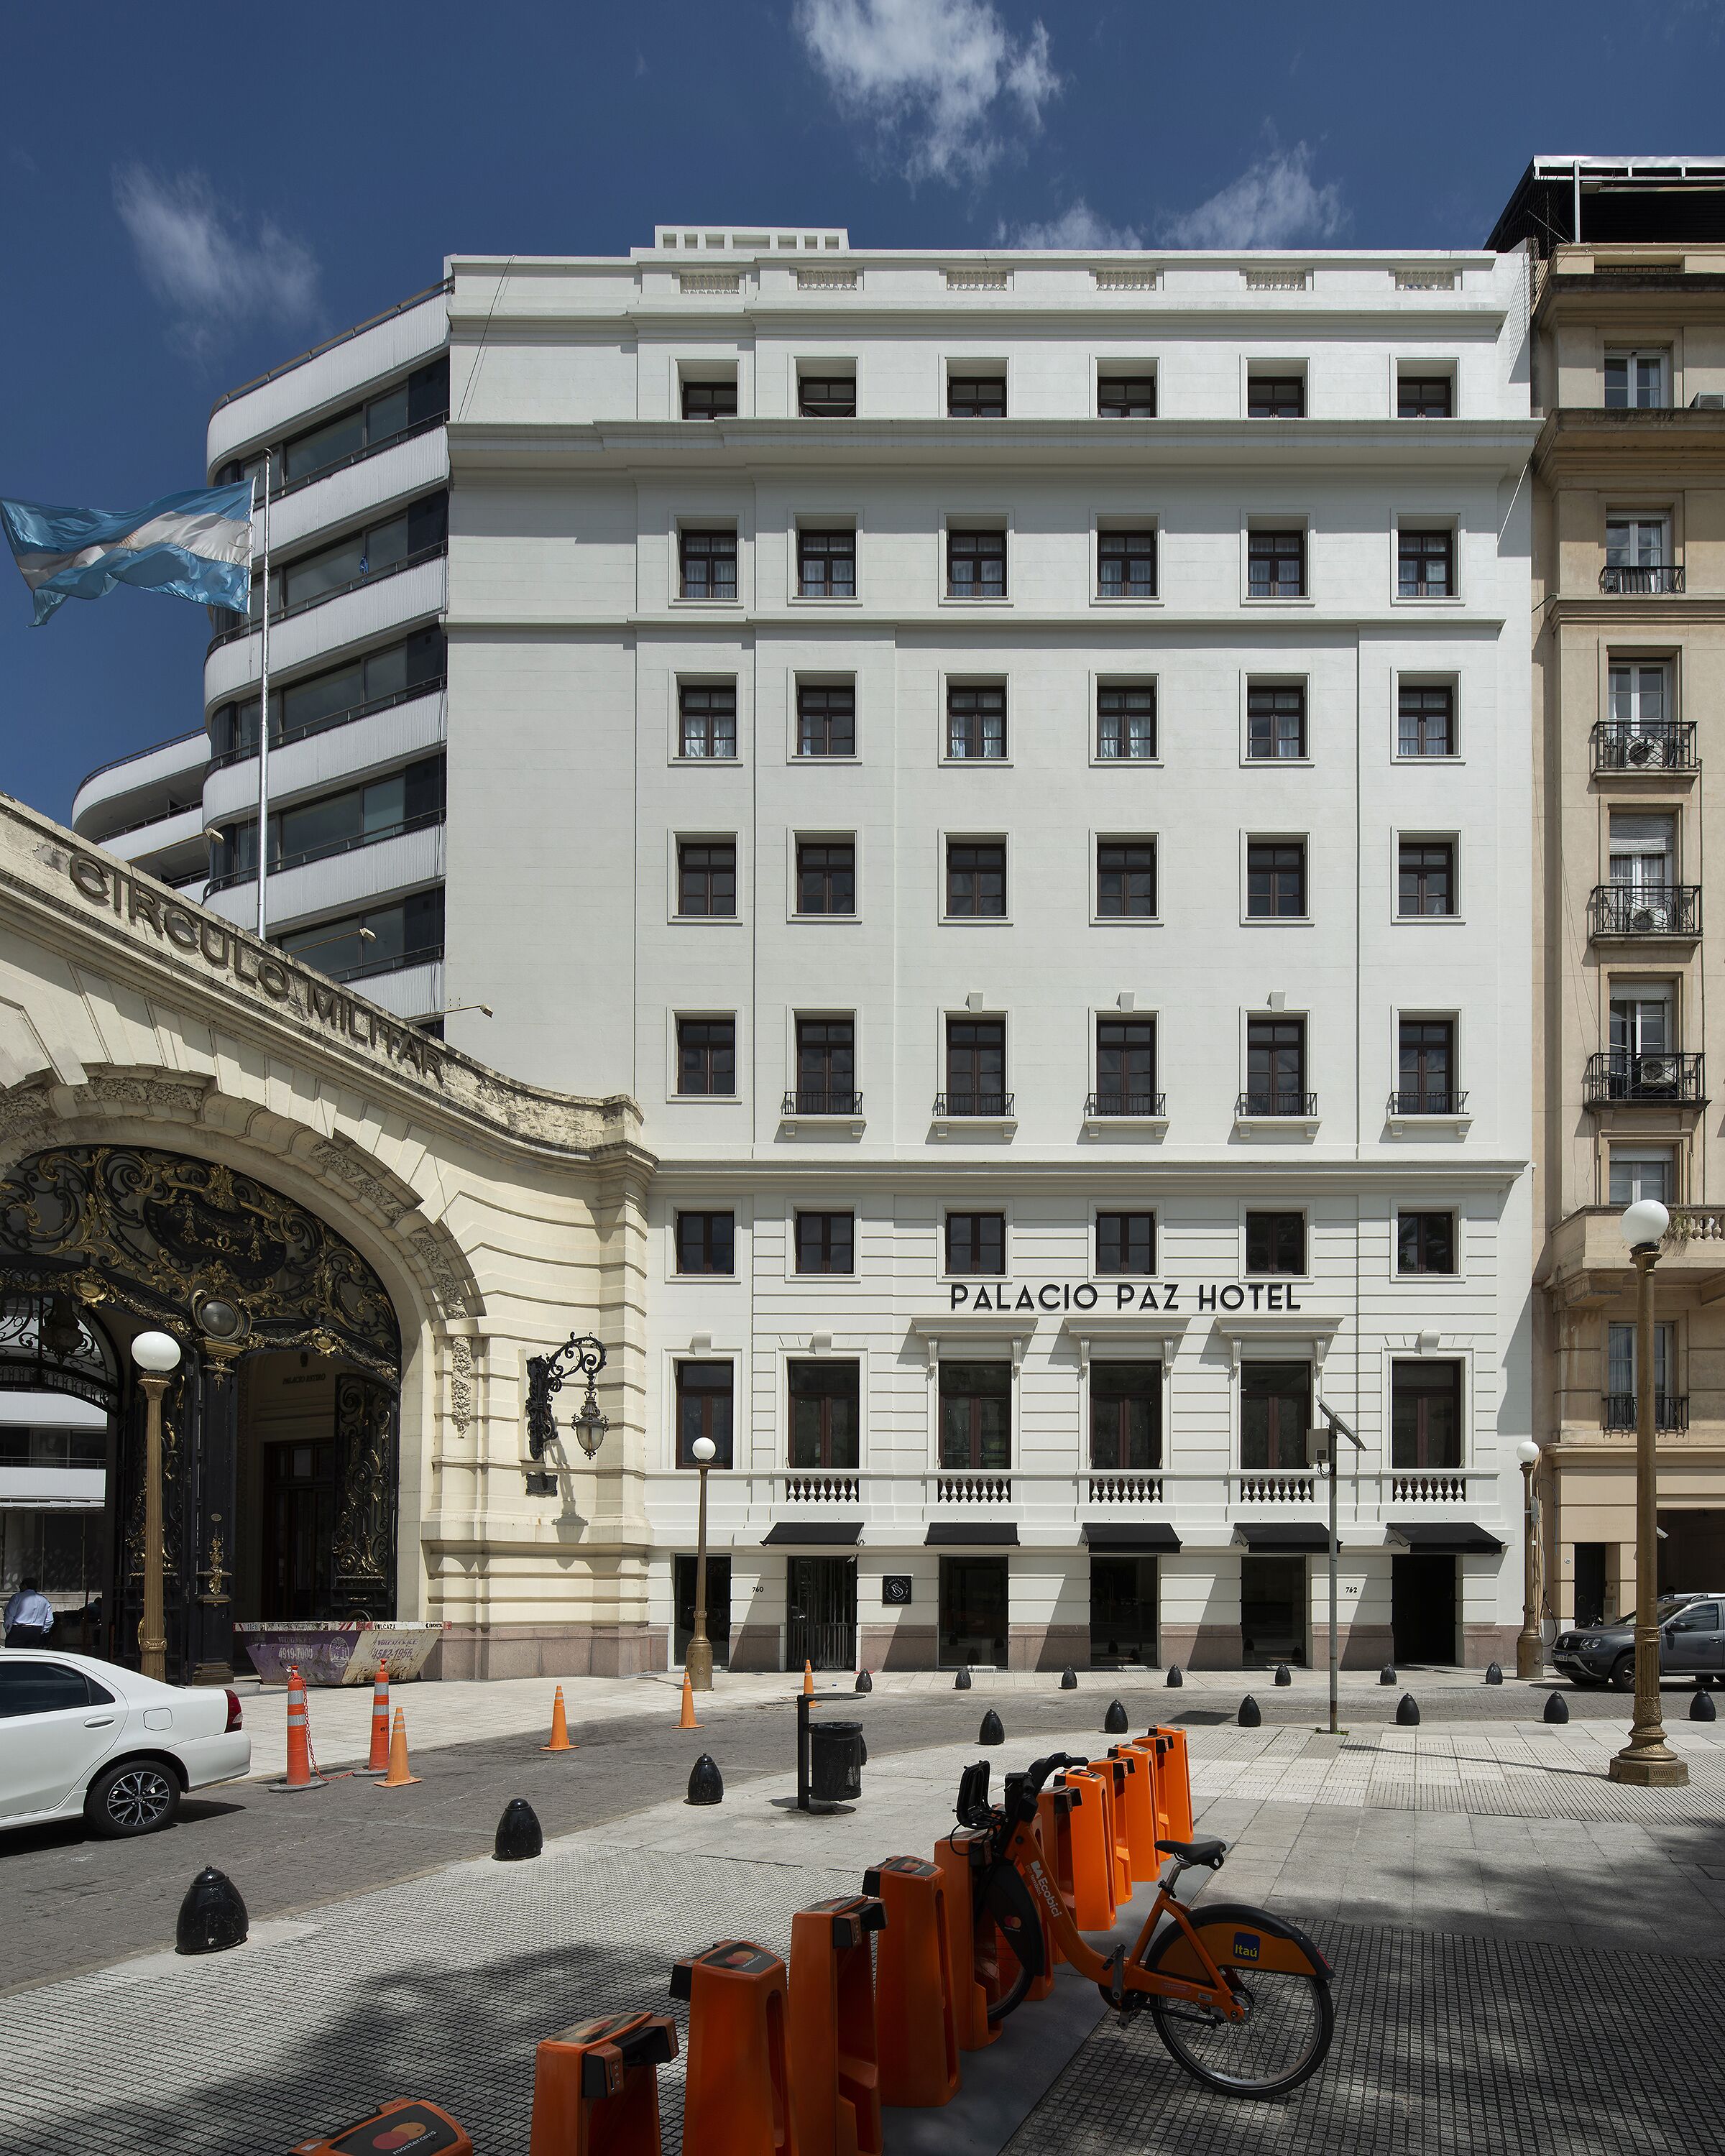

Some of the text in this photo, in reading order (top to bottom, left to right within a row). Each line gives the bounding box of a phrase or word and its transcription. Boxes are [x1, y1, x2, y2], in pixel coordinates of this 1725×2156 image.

[70, 852, 445, 1082] CIRCULO MILITAR
[951, 1284, 1301, 1309] PALACIO PAZ HOTEL
[1038, 1876, 1062, 1917] Ecobici
[1235, 1944, 1258, 1958] Itaú
[392, 2130, 437, 2155] mastercard
